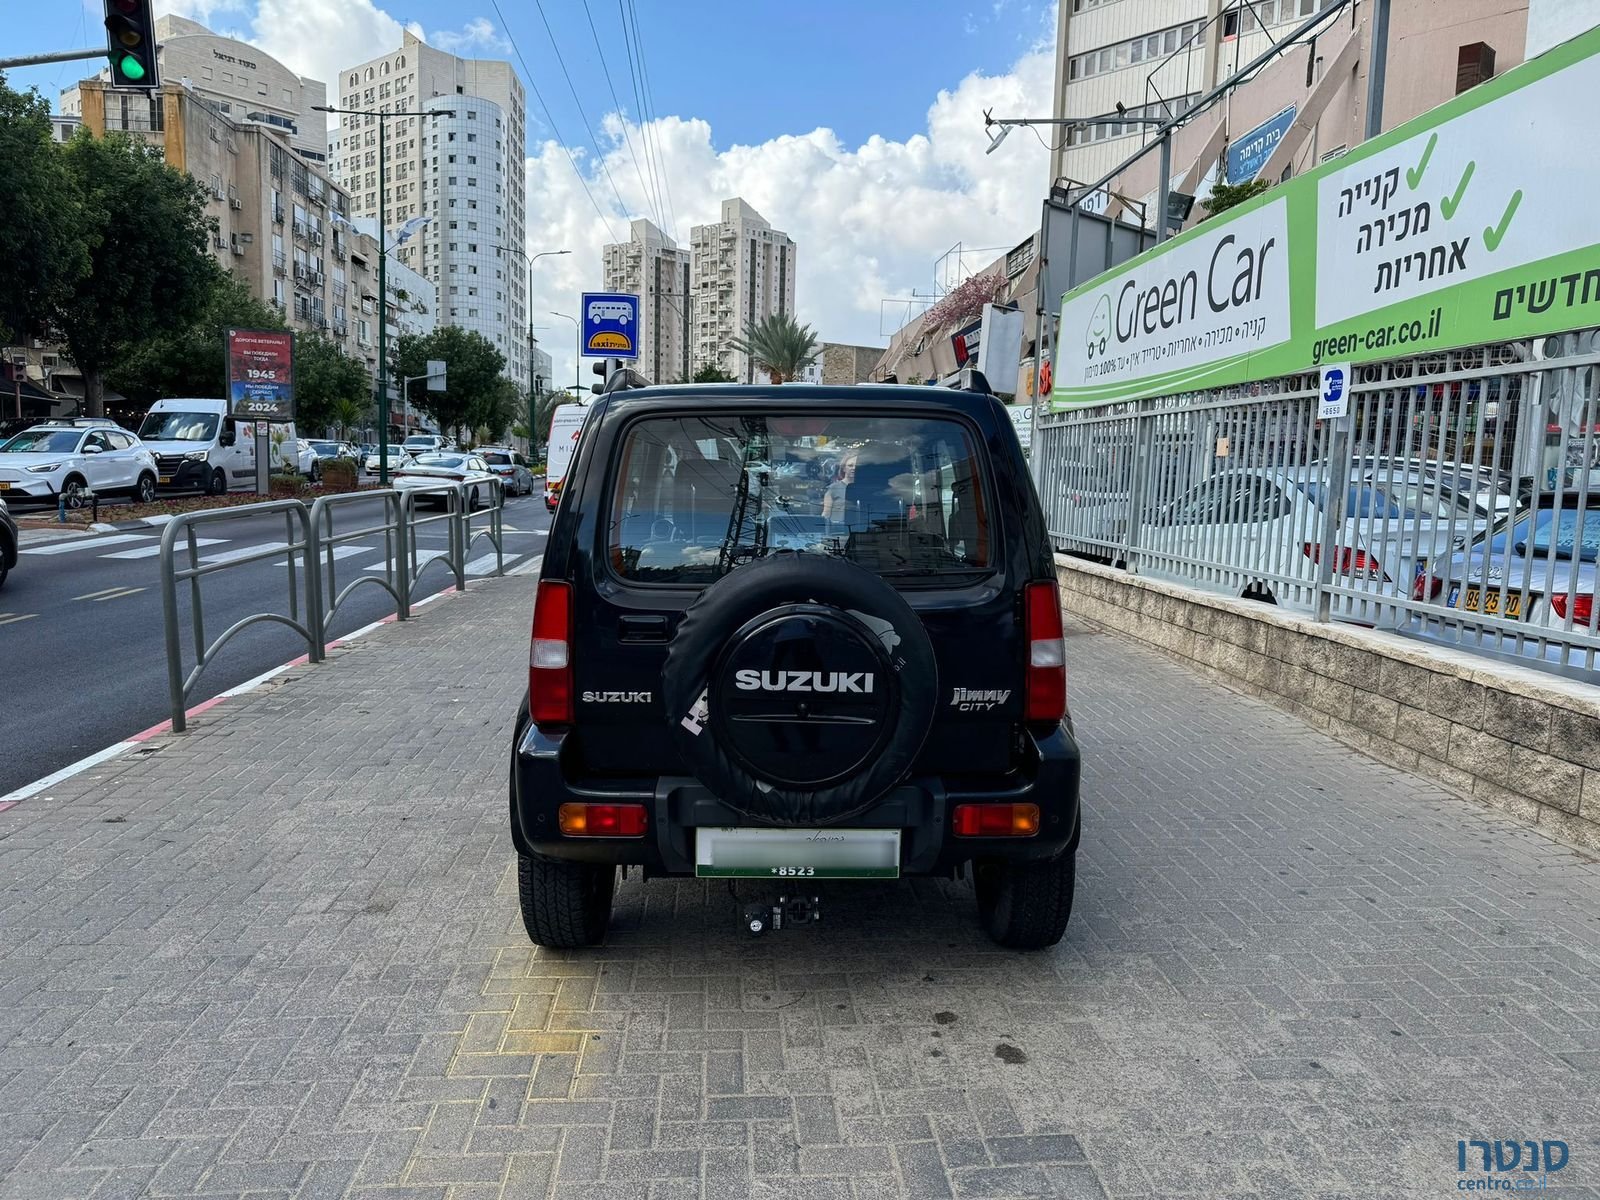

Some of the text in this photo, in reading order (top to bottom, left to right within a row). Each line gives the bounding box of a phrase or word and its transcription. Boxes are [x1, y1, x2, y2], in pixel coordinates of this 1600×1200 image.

[1240, 128, 1281, 161] בית קדימה
[1338, 166, 1399, 218] קנייה
[1356, 201, 1430, 254] מכירה
[1374, 236, 1470, 294] אחריות
[1116, 234, 1275, 343] Green Car
[1492, 268, 1600, 321] חדשים
[1204, 327, 1233, 348] מכירה
[1240, 316, 1266, 341] קניה
[1312, 307, 1442, 365] green-car.co.il
[1166, 335, 1197, 358] אחריות
[1099, 359, 1117, 375] 100%
[1129, 351, 1140, 372] אין
[247, 369, 276, 379] 1945
[248, 402, 279, 412] 2024
[735, 669, 875, 693] SUZUKI
[582, 691, 652, 703] SUZUKI
[959, 703, 996, 712] CITY
